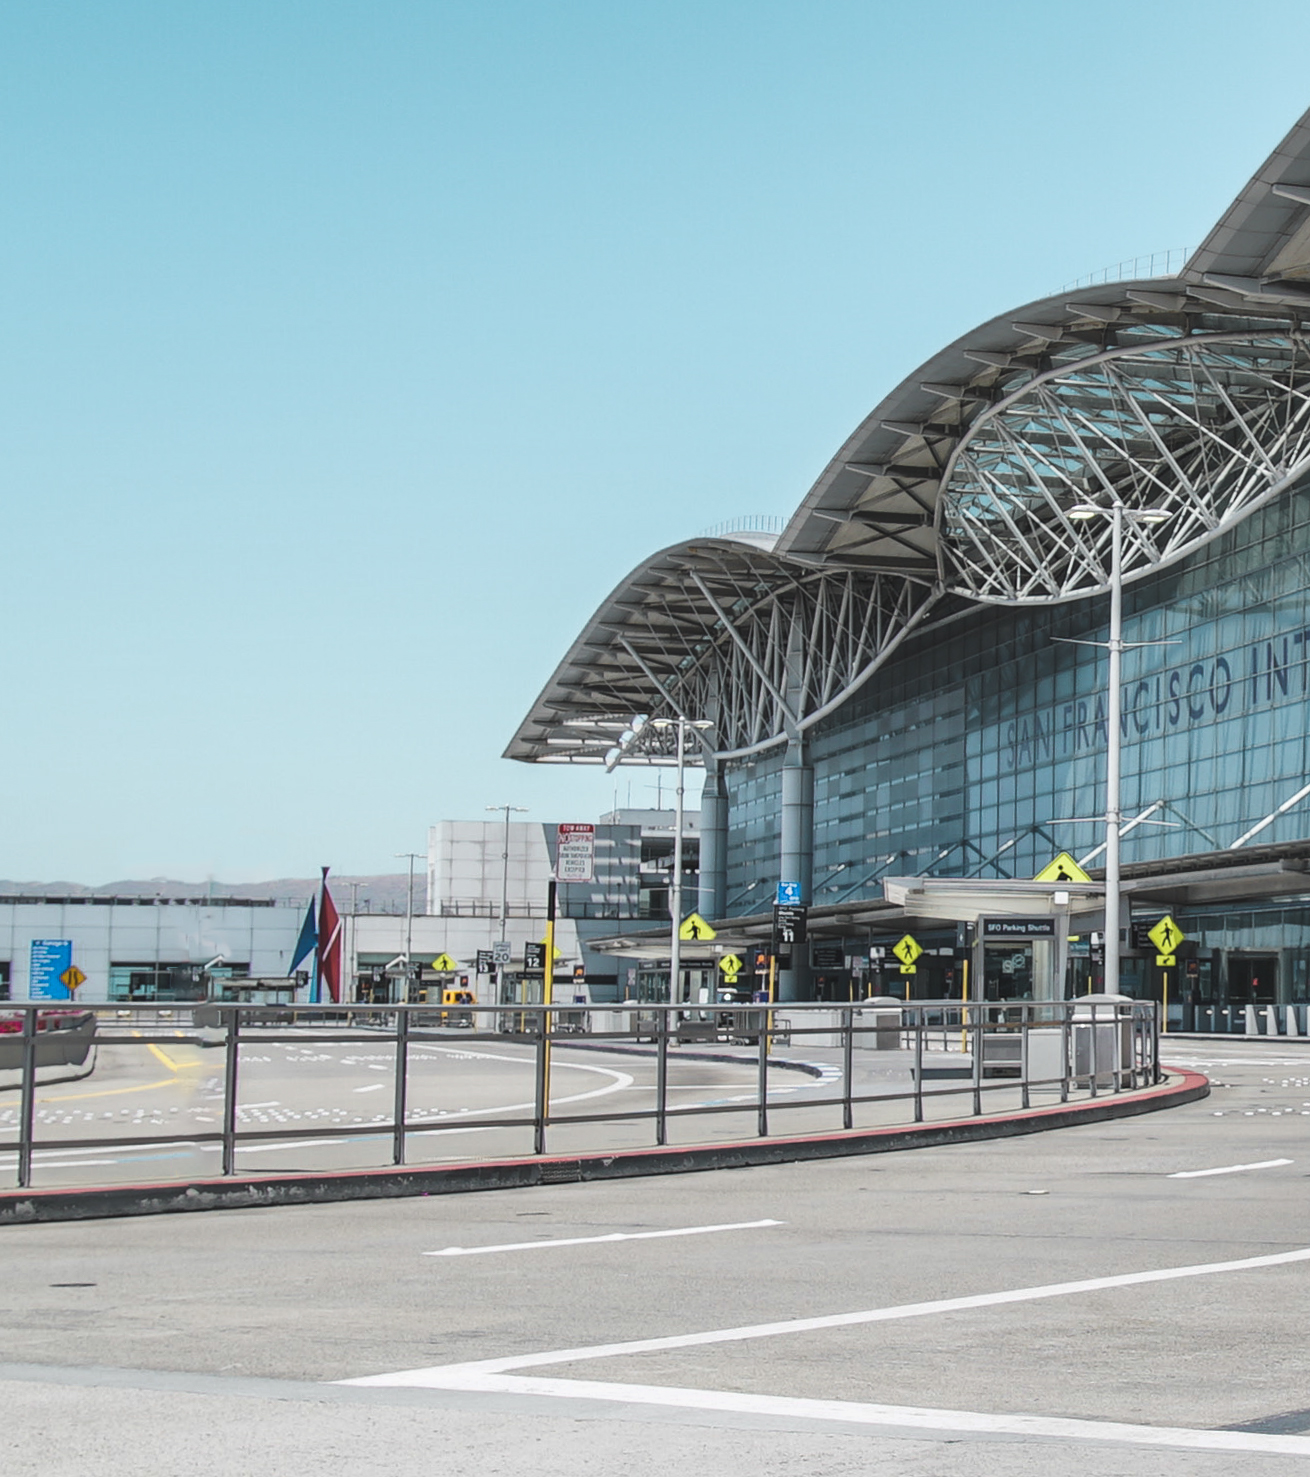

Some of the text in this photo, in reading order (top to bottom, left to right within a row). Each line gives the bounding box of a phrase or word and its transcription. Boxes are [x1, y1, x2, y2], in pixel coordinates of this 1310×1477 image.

[1007, 710, 1050, 768] SAN
[1063, 656, 1231, 754] FRANCISCO
[784, 886, 793, 896] 4
[988, 923, 1051, 933] SFO Parking Shuttle
[783, 930, 794, 942] 11
[494, 952, 509, 961] 20
[526, 957, 540, 967] 12
